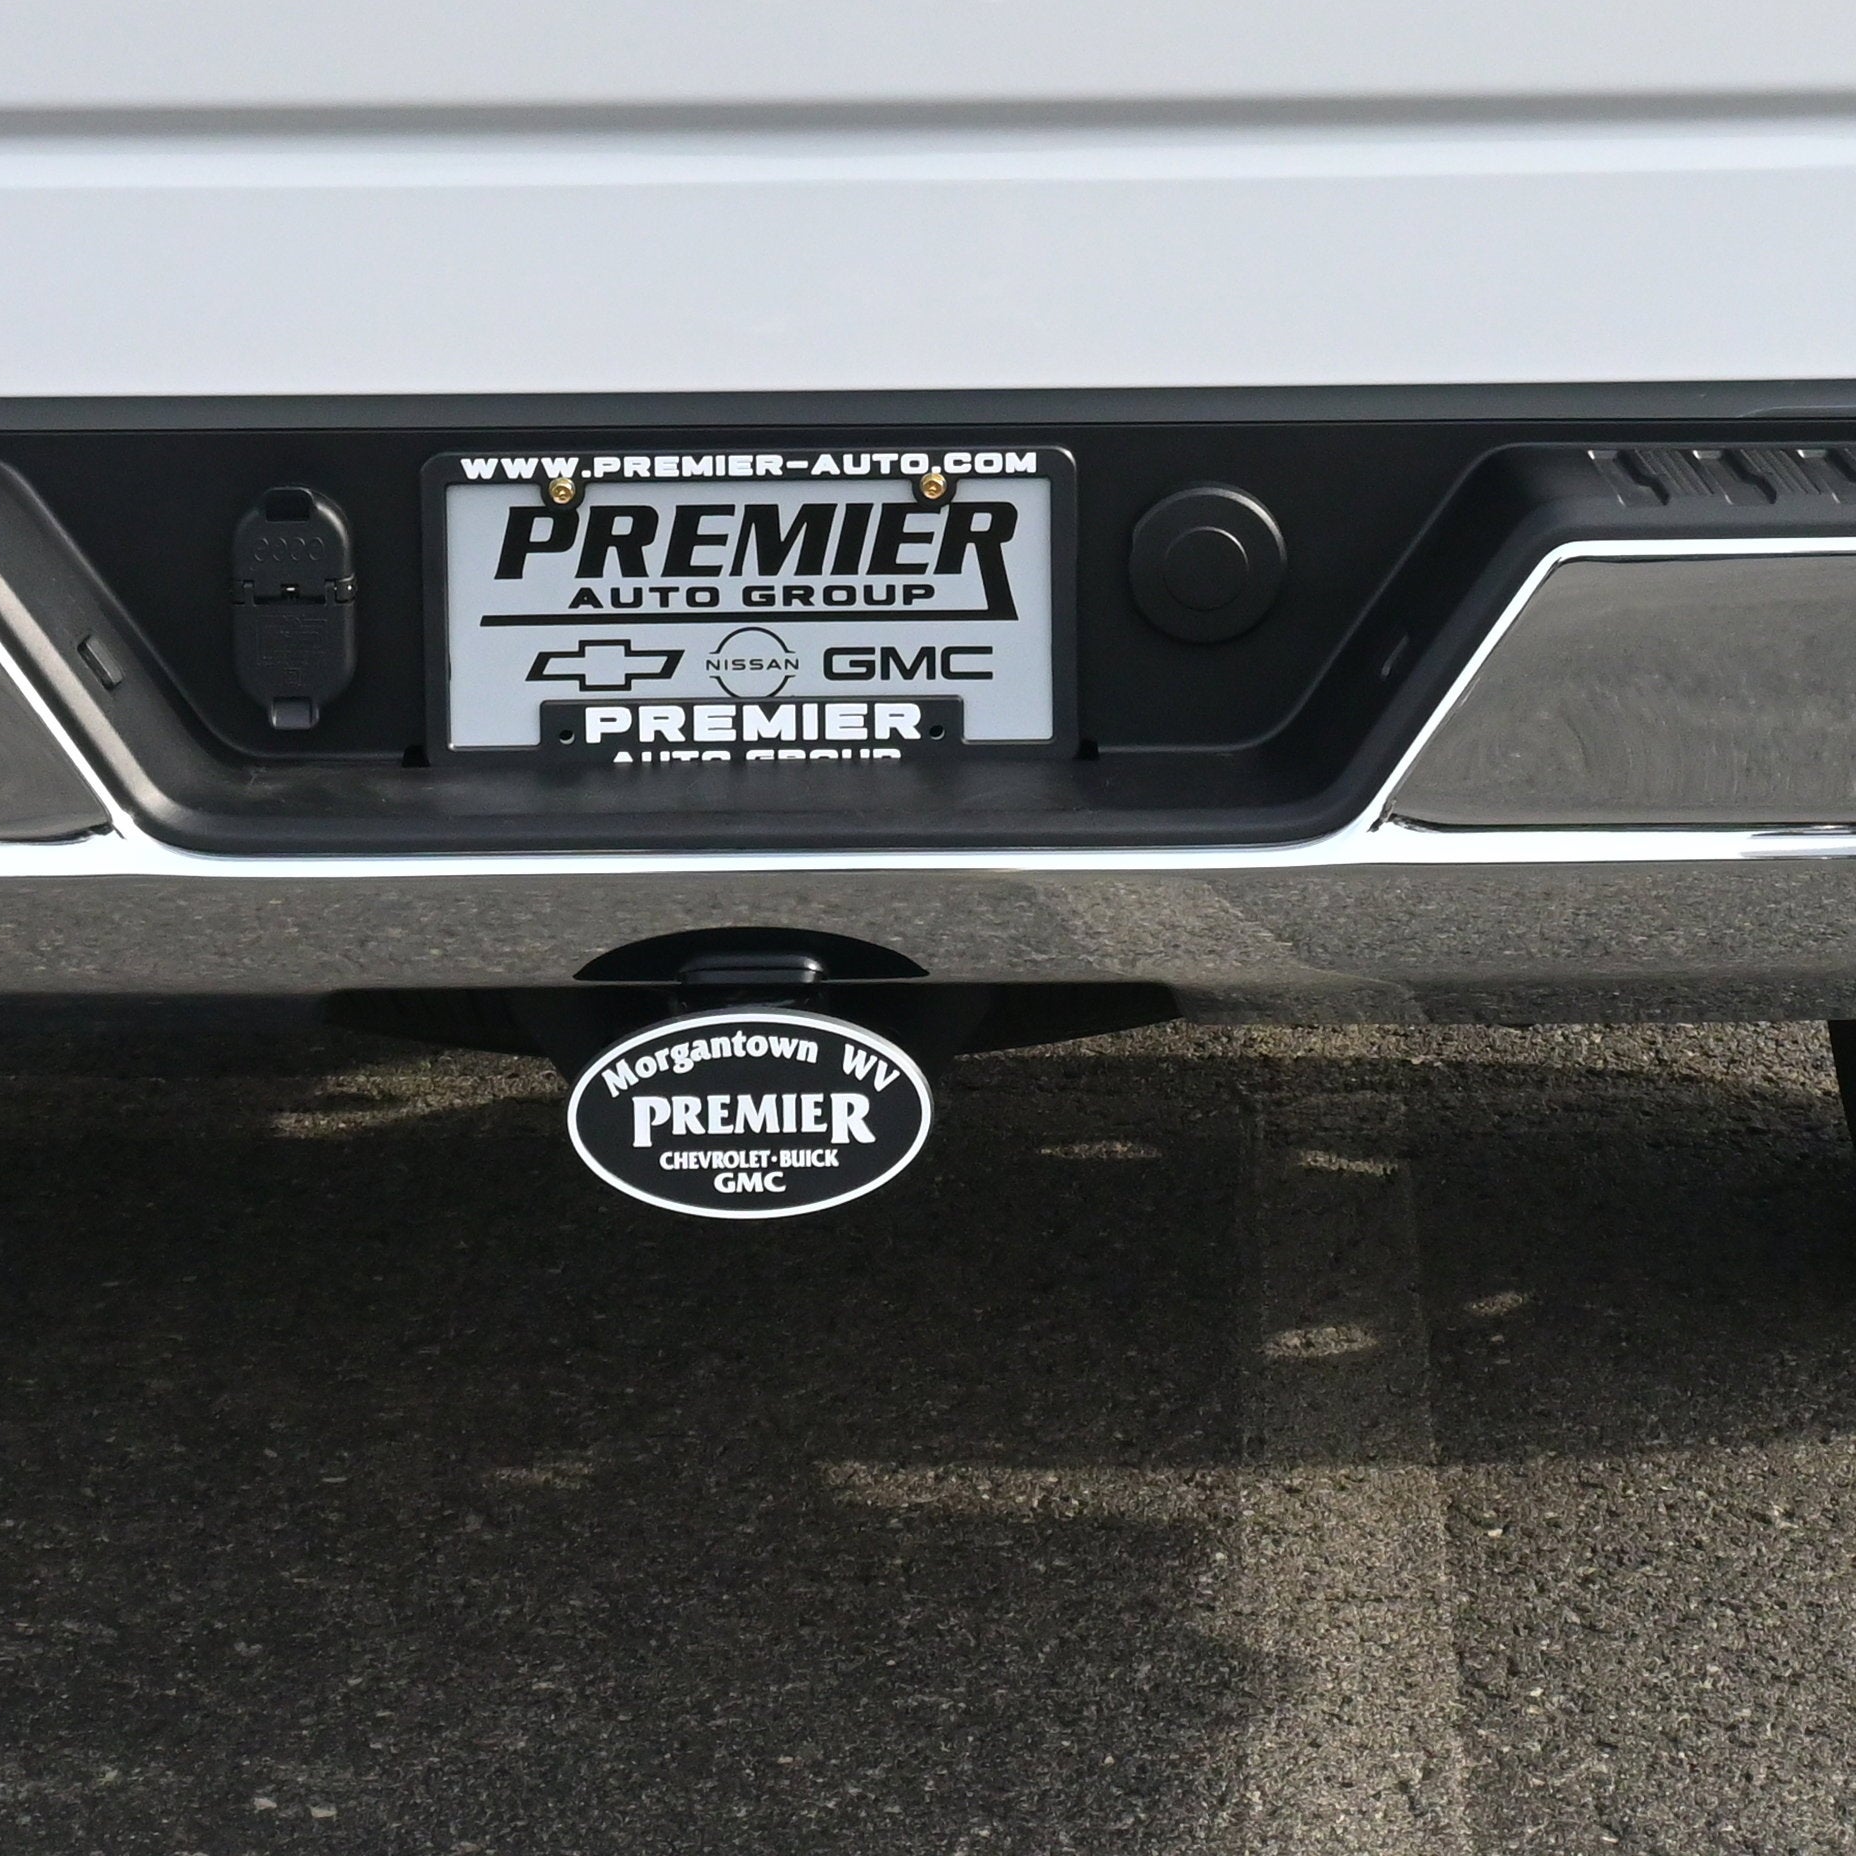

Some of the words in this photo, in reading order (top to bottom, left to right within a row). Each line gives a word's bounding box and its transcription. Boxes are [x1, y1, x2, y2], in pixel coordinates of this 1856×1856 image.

[460, 452, 1038, 480] WWW.PREMIER-AUTO.COM
[494, 501, 1019, 582] PREMIER
[568, 587, 720, 609] AUTO
[742, 584, 935, 608] GROUP
[705, 658, 799, 671] NISSAN
[823, 646, 994, 681] GMC
[585, 702, 922, 744] PREMIER
[600, 1030, 819, 1098] Morgantown
[841, 1043, 901, 1093] WV
[631, 1092, 876, 1148] PREMIER
[713, 1171, 787, 1194] GMC
